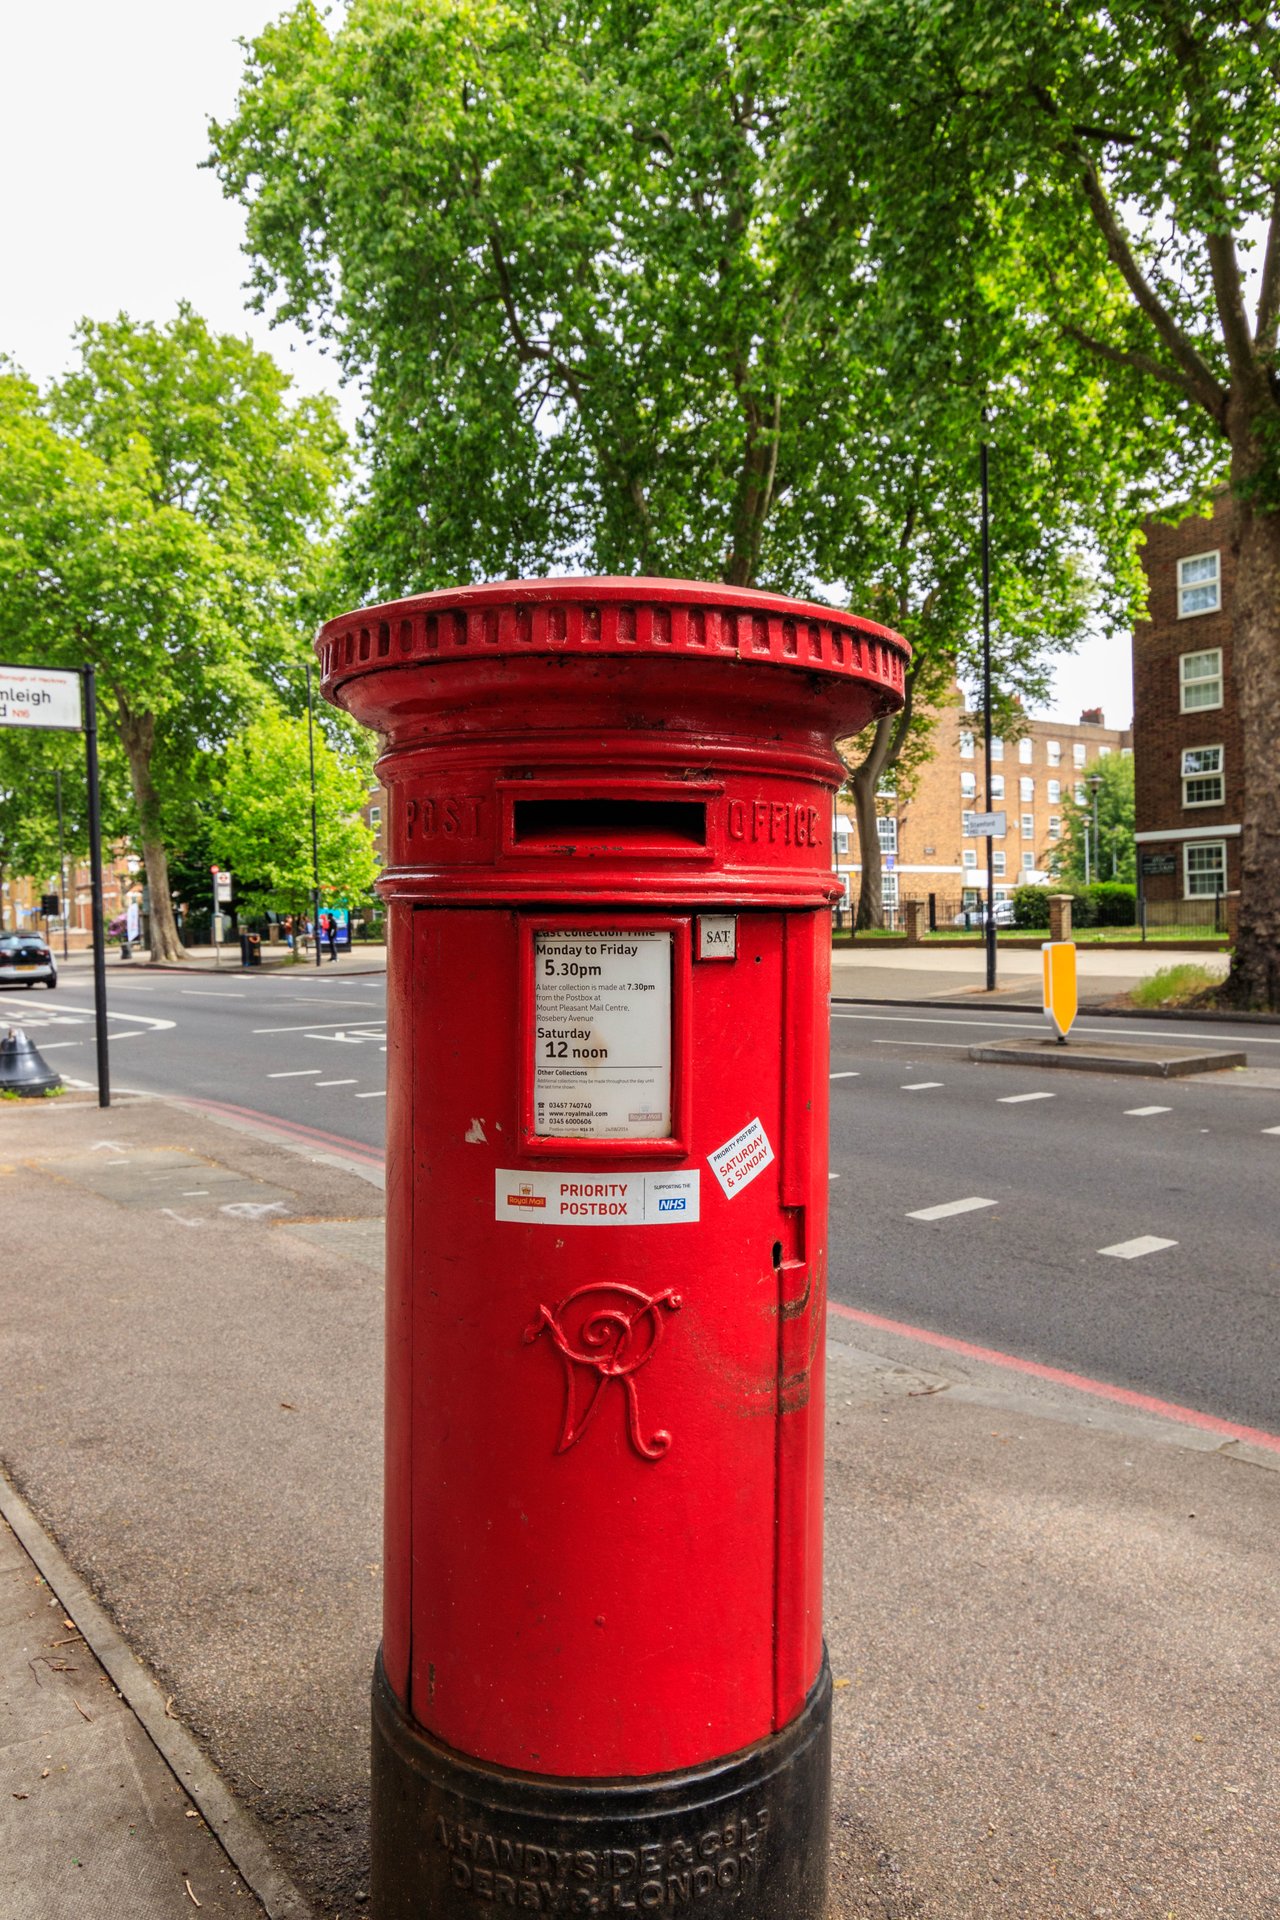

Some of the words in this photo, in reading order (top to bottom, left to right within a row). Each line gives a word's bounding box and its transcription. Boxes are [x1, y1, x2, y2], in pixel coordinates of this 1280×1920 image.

[405, 796, 486, 840] POST
[706, 930, 730, 944] SAT
[536, 944, 582, 957] Monday
[585, 945, 597, 955] to
[600, 944, 638, 957] Friday
[545, 959, 602, 978] 5.30pm
[627, 983, 655, 992] 7.30pm
[536, 1004, 558, 1012] Mount
[559, 1004, 588, 1012] Pleasant
[590, 1004, 604, 1012] Mail
[536, 1014, 567, 1023] Rosebery
[537, 1028, 591, 1041] Saturday
[545, 1041, 568, 1058] 12
[572, 1048, 608, 1058] noon
[713, 1141, 737, 1162] PRIORITY
[735, 1124, 758, 1145] POSTBOX
[719, 1134, 764, 1177] SATURDAY
[727, 1177, 735, 1188] &
[734, 1145, 768, 1181] SUNDAY
[560, 1184, 628, 1197] PRIORITY
[509, 1196, 528, 1205] Royal
[529, 1198, 545, 1206] Mail
[659, 1199, 685, 1210] NHS
[560, 1202, 628, 1216] POSTBOX
[610, 1847, 760, 1911] LONDON
